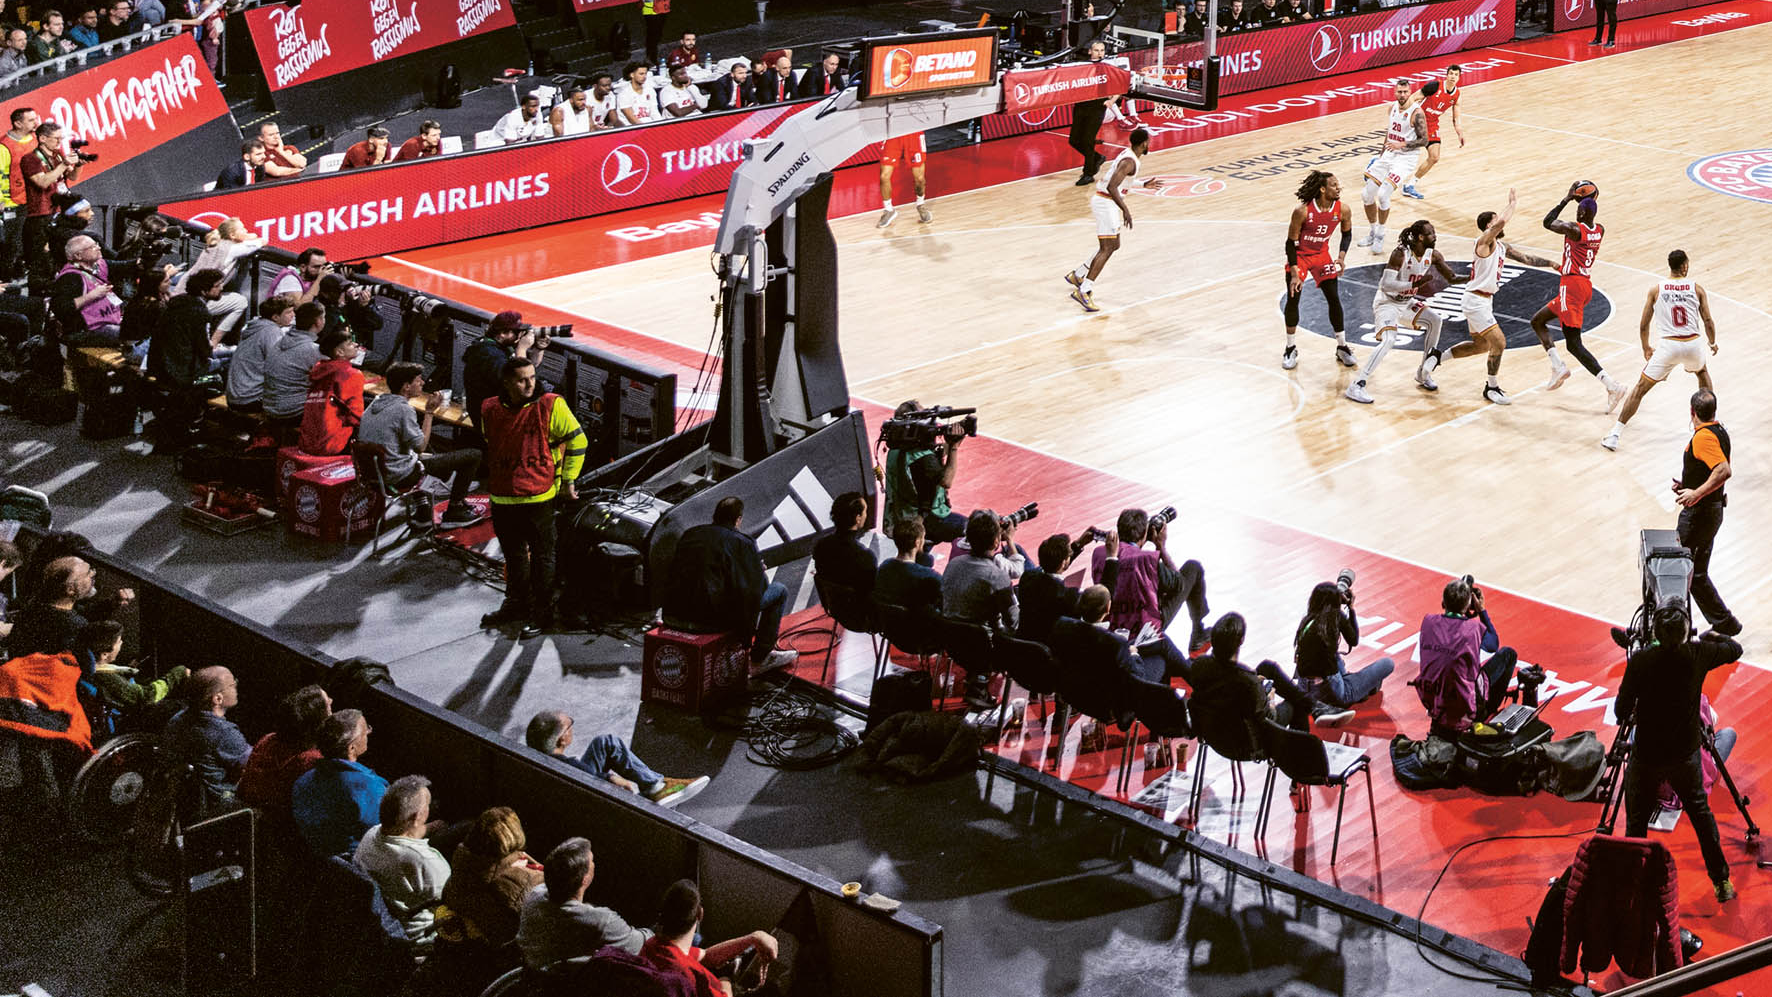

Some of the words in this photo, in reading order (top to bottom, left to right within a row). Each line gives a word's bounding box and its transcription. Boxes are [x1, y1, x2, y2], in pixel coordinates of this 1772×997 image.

[269, 5, 301, 41] ROT
[278, 18, 307, 59] GEGEN
[370, 2, 421, 60] RASSISMUS
[1351, 22, 1423, 53] TURKISH
[1427, 10, 1497, 39] AIRLINES
[274, 24, 331, 87] RASSISMUS
[914, 50, 977, 73] BETANO
[1032, 80, 1070, 96] TURKISH
[1071, 74, 1107, 91] AIRLINES
[1253, 85, 1370, 116] DOME
[1392, 122, 1402, 132] 20
[1201, 146, 1319, 174] TURKISH
[1321, 128, 1388, 148] AIRLIN
[768, 151, 811, 197] SPALDING
[1712, 176, 1757, 193] FC
[255, 197, 403, 245] TURKISH
[414, 173, 550, 219] AIRLINES
[1316, 225, 1327, 234] 33
[1585, 249, 1593, 266] 9
[1671, 306, 1688, 327] 0
